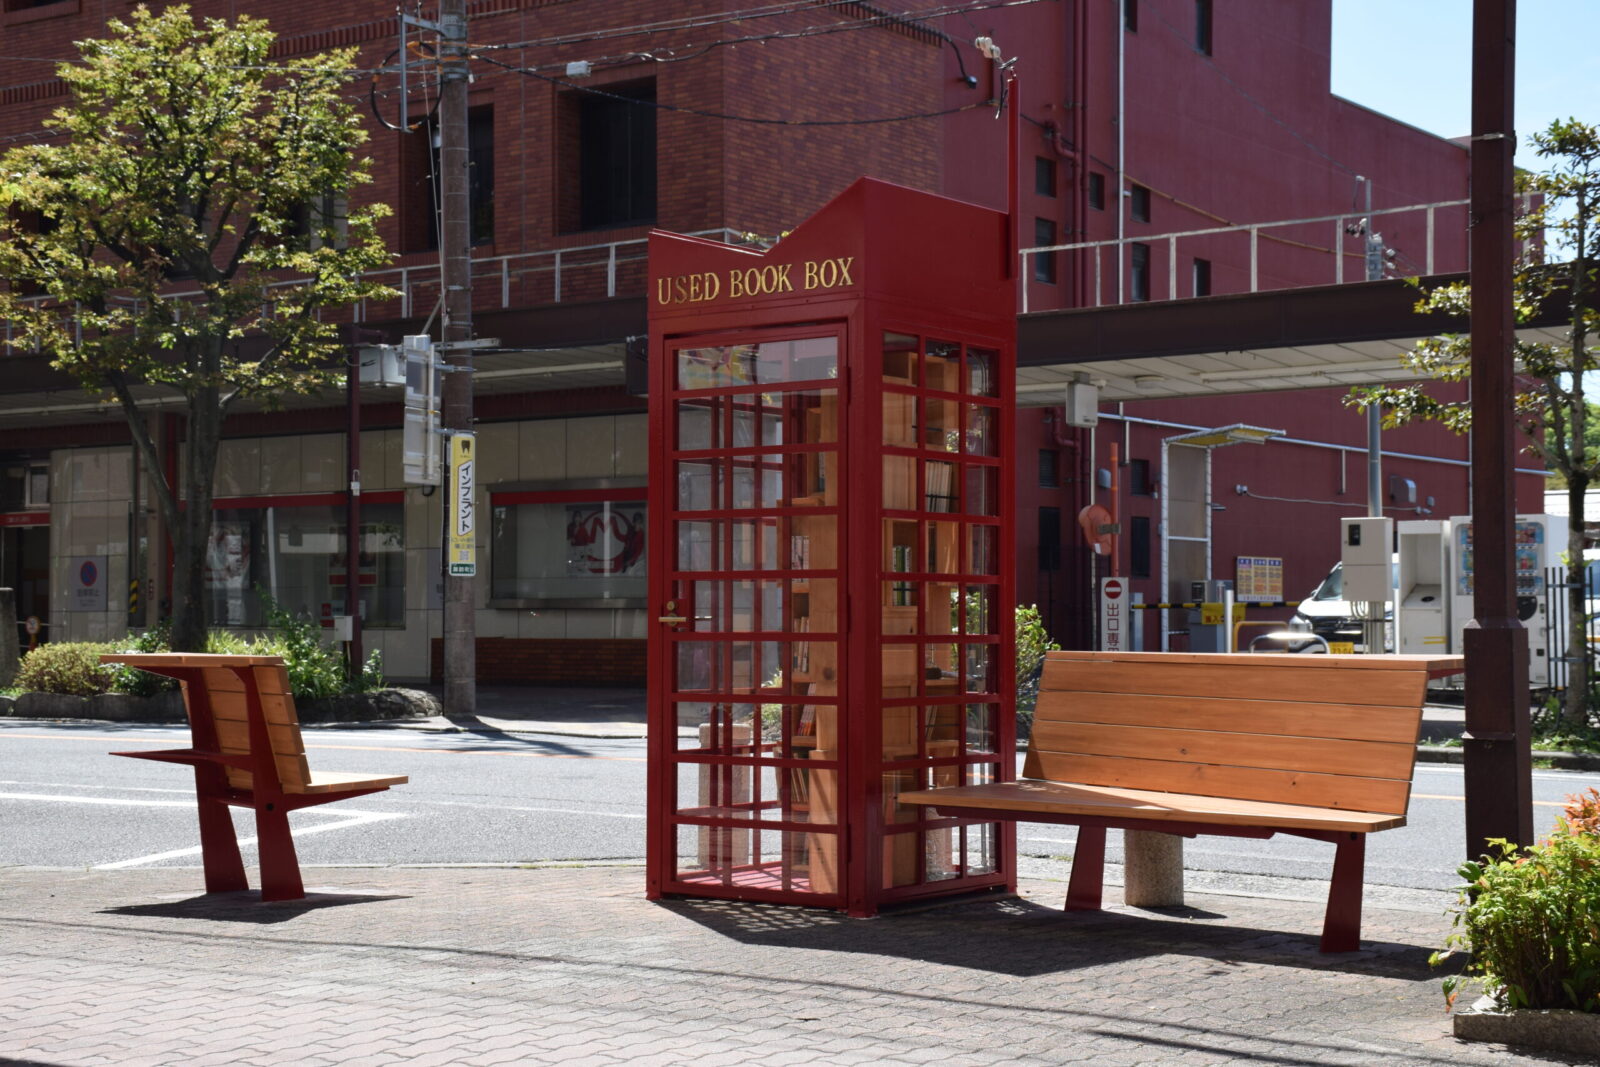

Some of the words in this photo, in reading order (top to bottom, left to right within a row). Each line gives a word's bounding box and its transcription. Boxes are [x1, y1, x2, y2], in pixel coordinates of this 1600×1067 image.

[657, 272, 720, 305] USED
[729, 264, 793, 298] BOOK
[804, 257, 854, 291] BOX
